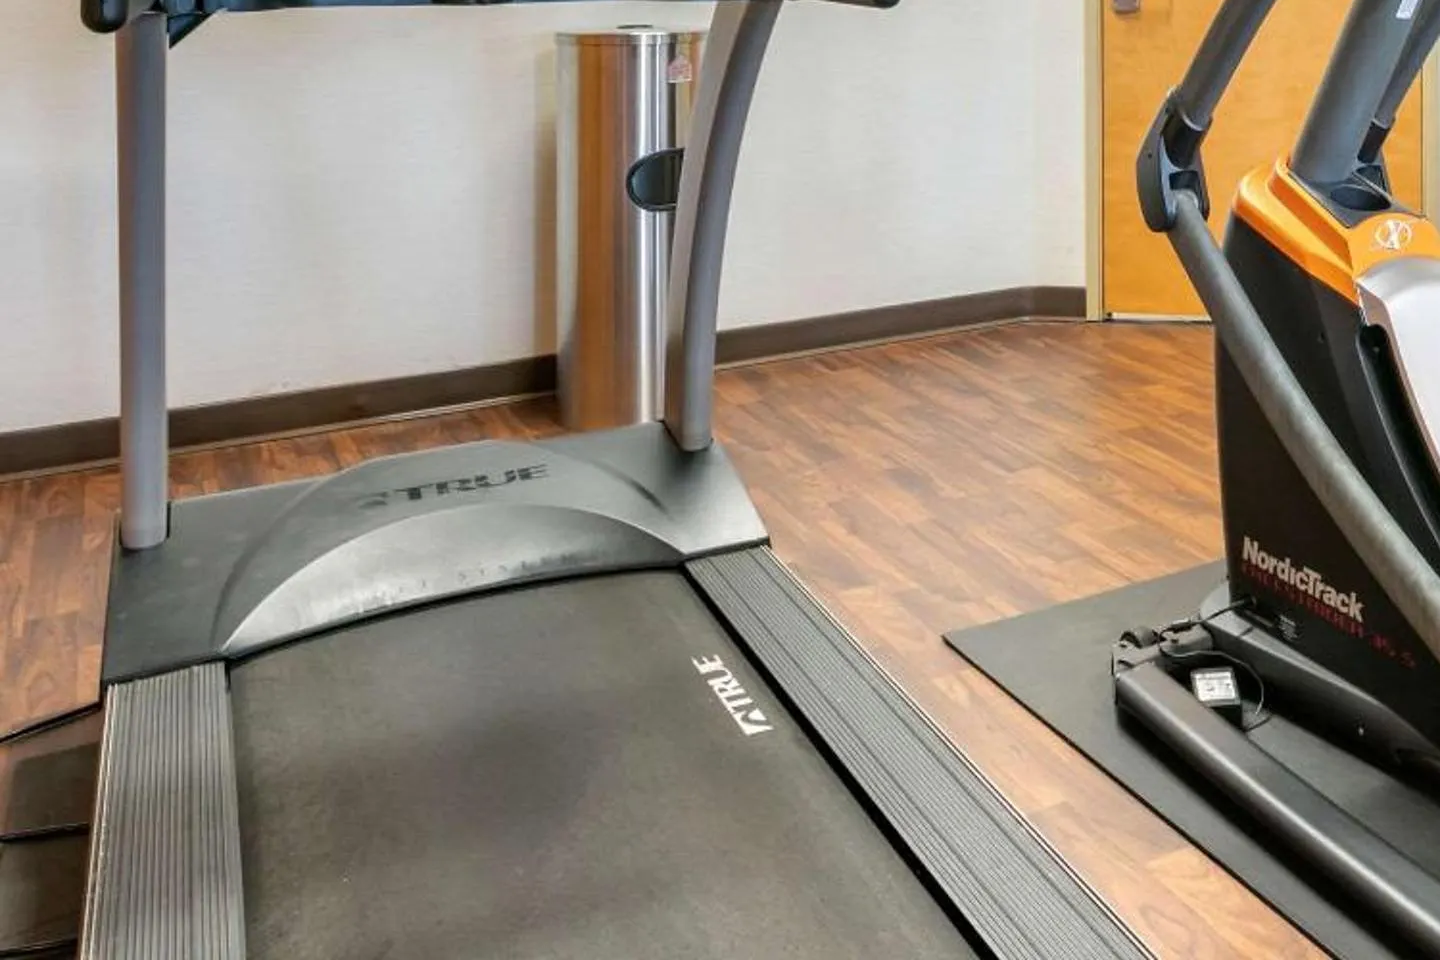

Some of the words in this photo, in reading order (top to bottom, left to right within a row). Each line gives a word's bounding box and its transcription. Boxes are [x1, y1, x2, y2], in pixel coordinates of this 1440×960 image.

[393, 462, 549, 501] TRUE
[1242, 535, 1366, 623] NordicTrack
[691, 654, 753, 714] TRUE
